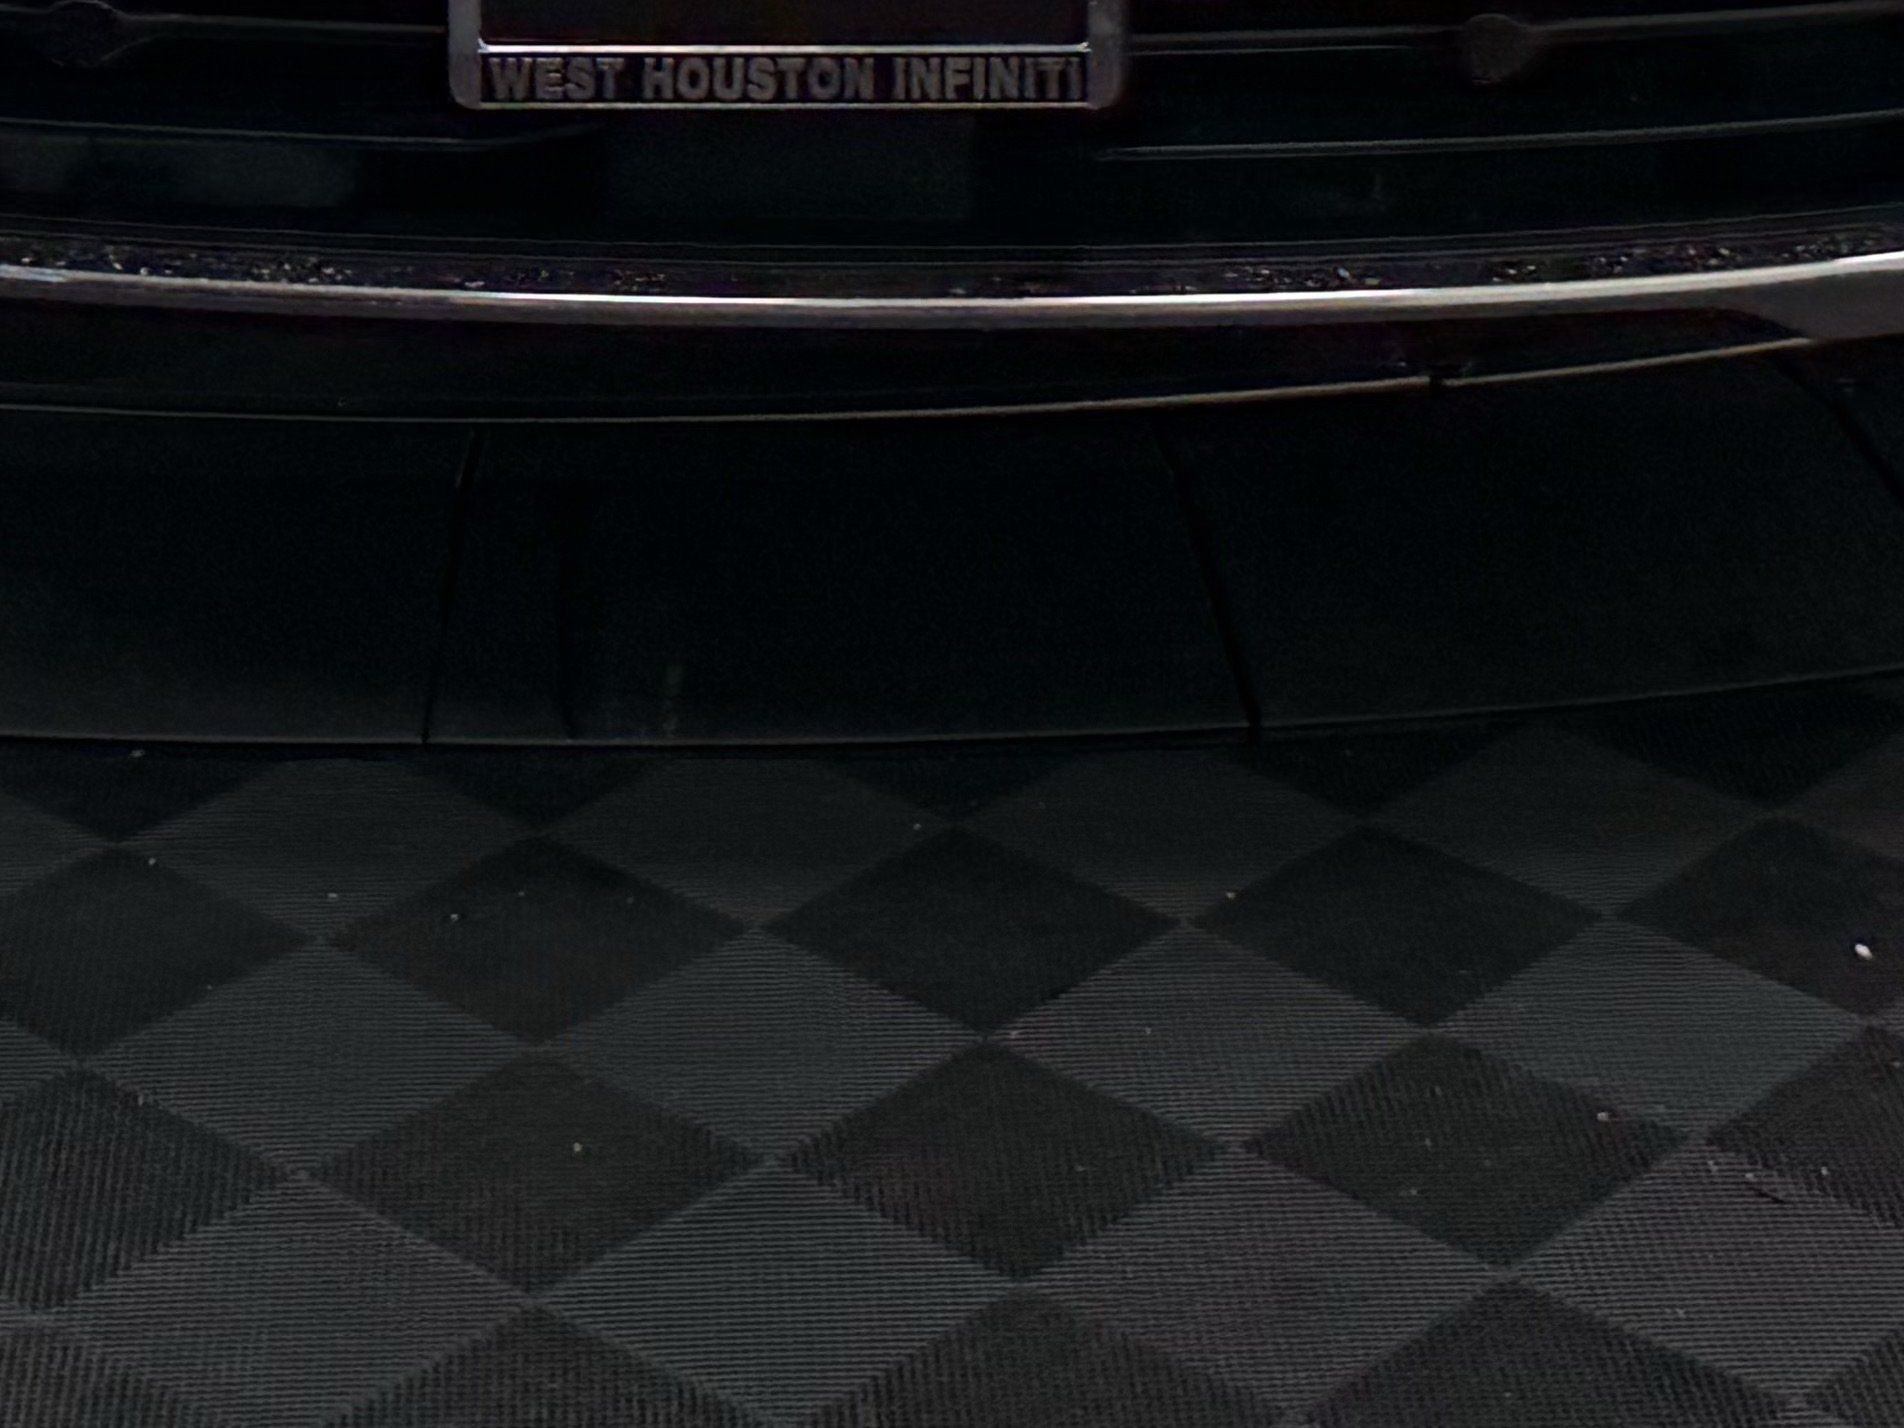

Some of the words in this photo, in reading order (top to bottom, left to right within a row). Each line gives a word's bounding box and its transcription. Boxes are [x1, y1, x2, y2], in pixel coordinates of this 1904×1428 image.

[488, 58, 620, 101] WEST
[642, 57, 875, 101] HOUSTON
[896, 58, 1084, 101] INFINITI
